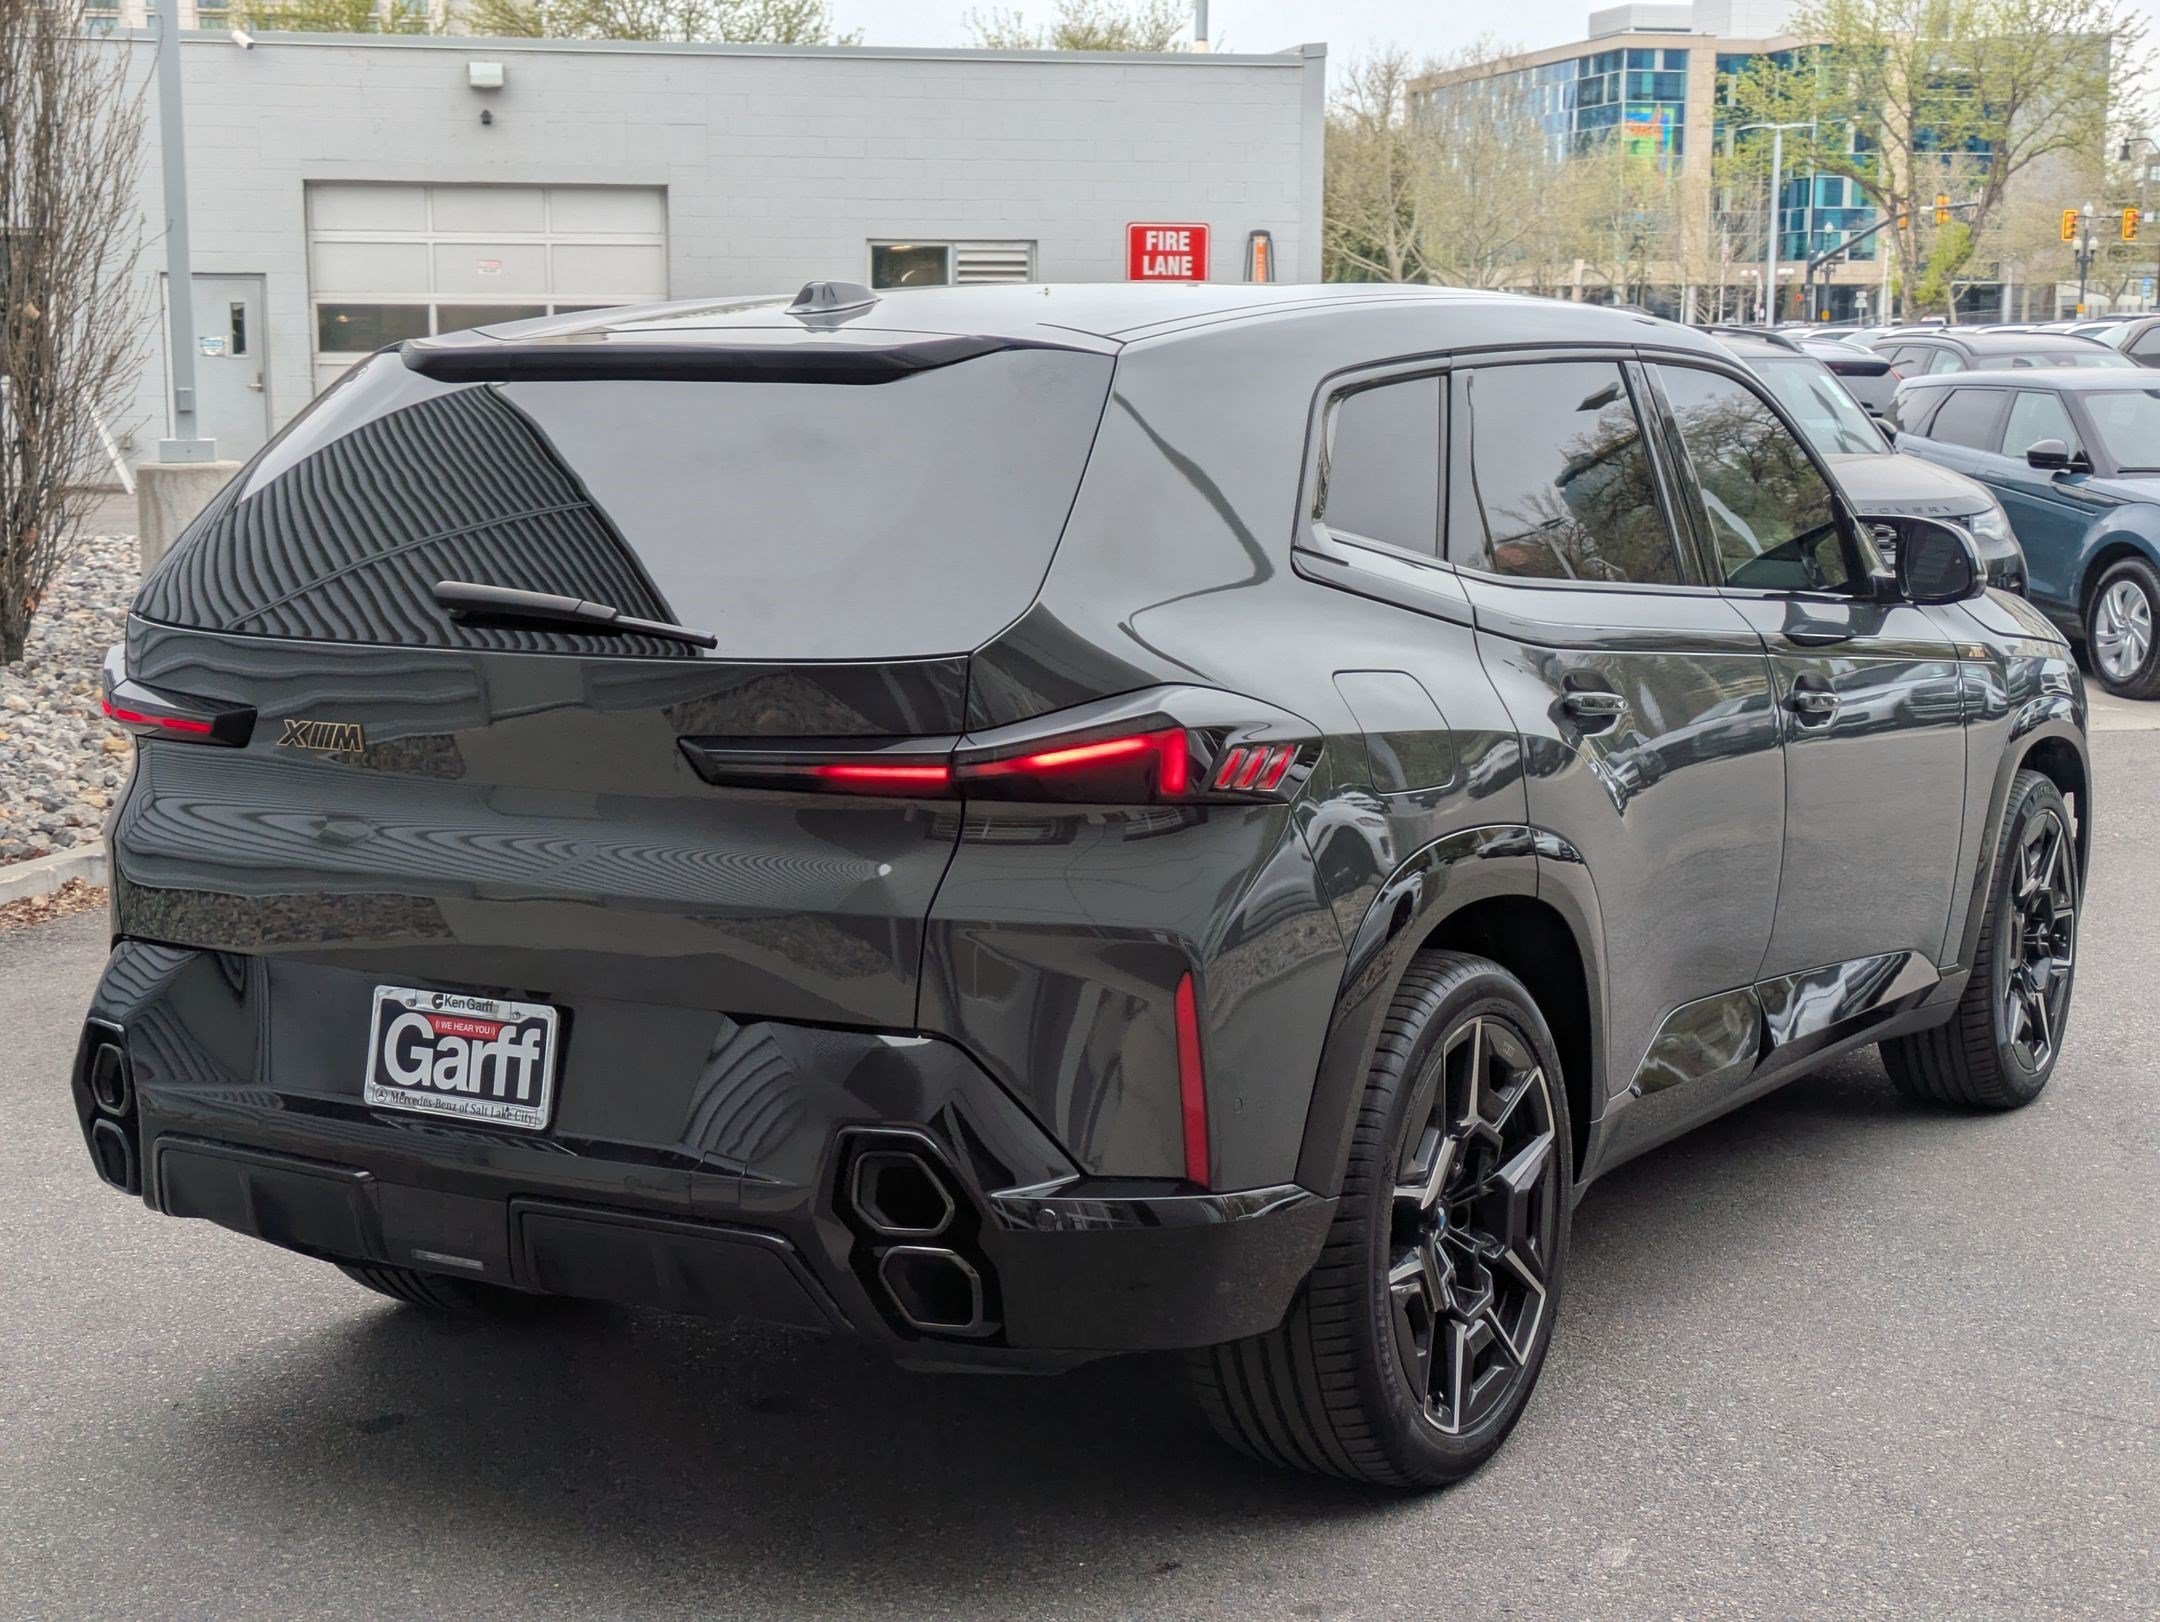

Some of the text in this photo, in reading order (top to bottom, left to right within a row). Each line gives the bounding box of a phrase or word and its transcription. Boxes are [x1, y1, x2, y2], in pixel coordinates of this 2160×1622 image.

[1145, 230, 1191, 252] FIRE
[1143, 255, 1193, 277] LANE
[444, 994, 466, 1009] Ken
[466, 998, 494, 1014] Garff
[440, 1020, 491, 1035] WE HEAR YOU
[384, 1012, 541, 1100] Garff
[389, 1089, 534, 1126] Mercedes-Benz of Salt Lake City
